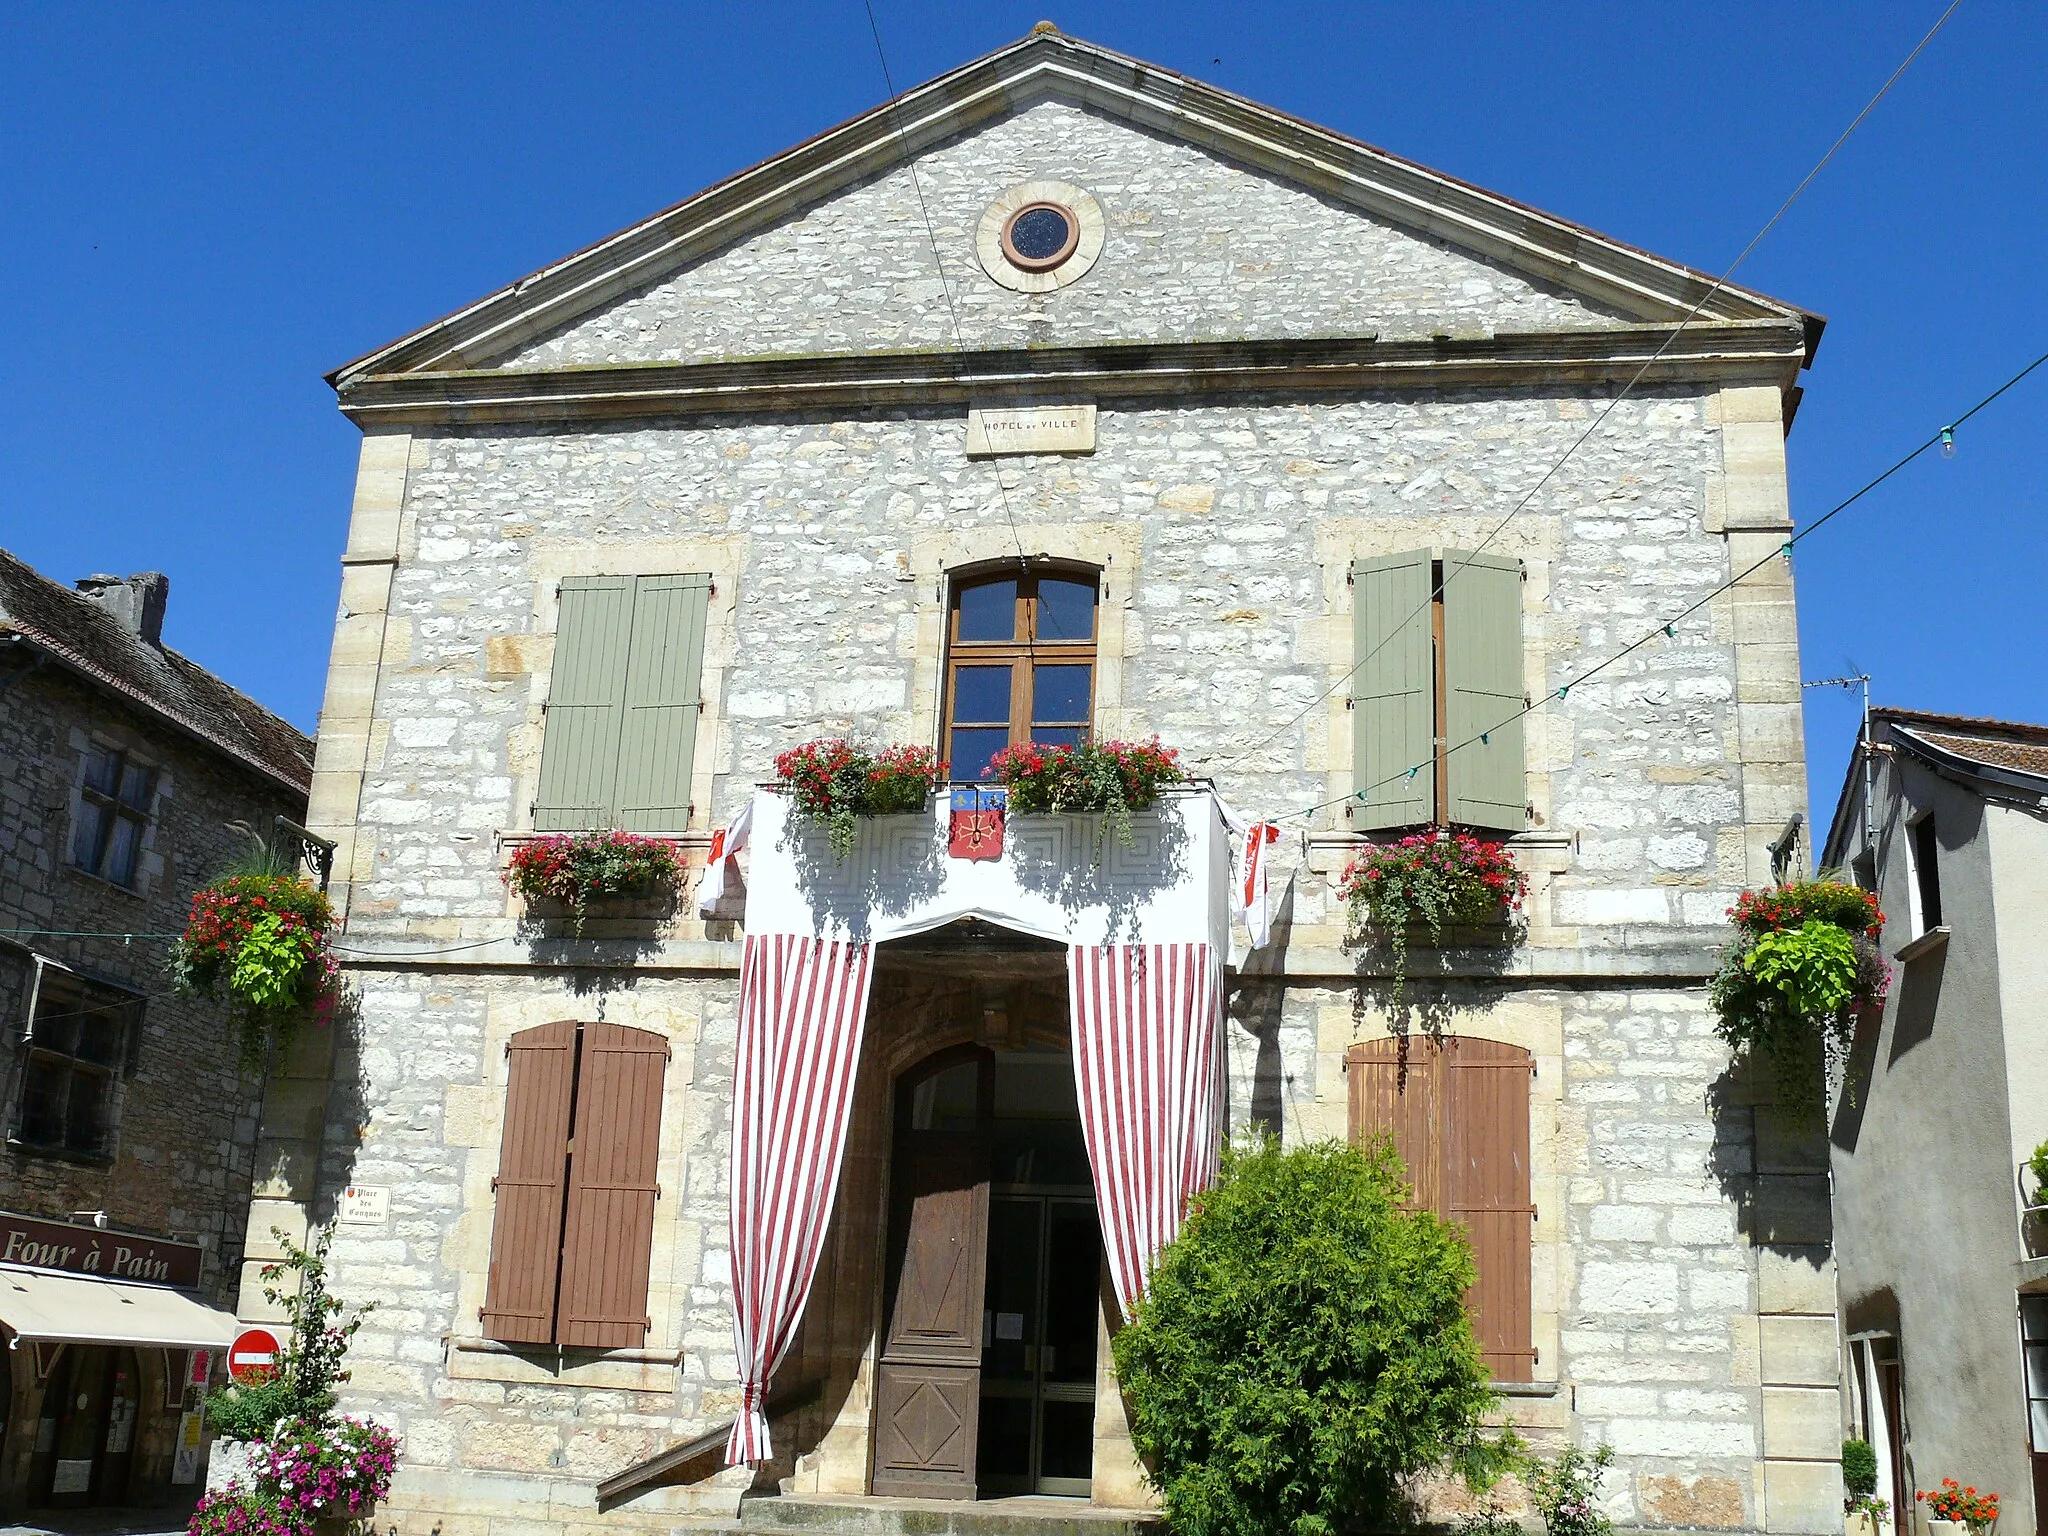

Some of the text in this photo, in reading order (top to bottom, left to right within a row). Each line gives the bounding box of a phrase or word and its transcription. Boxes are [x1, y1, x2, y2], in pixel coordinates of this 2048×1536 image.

[984, 422, 1023, 430] HOTEL
[1041, 420, 1077, 428] VILLE
[357, 1188, 378, 1198] Place
[359, 1199, 372, 1207] des
[1, 1230, 169, 1281] Four à Pain
